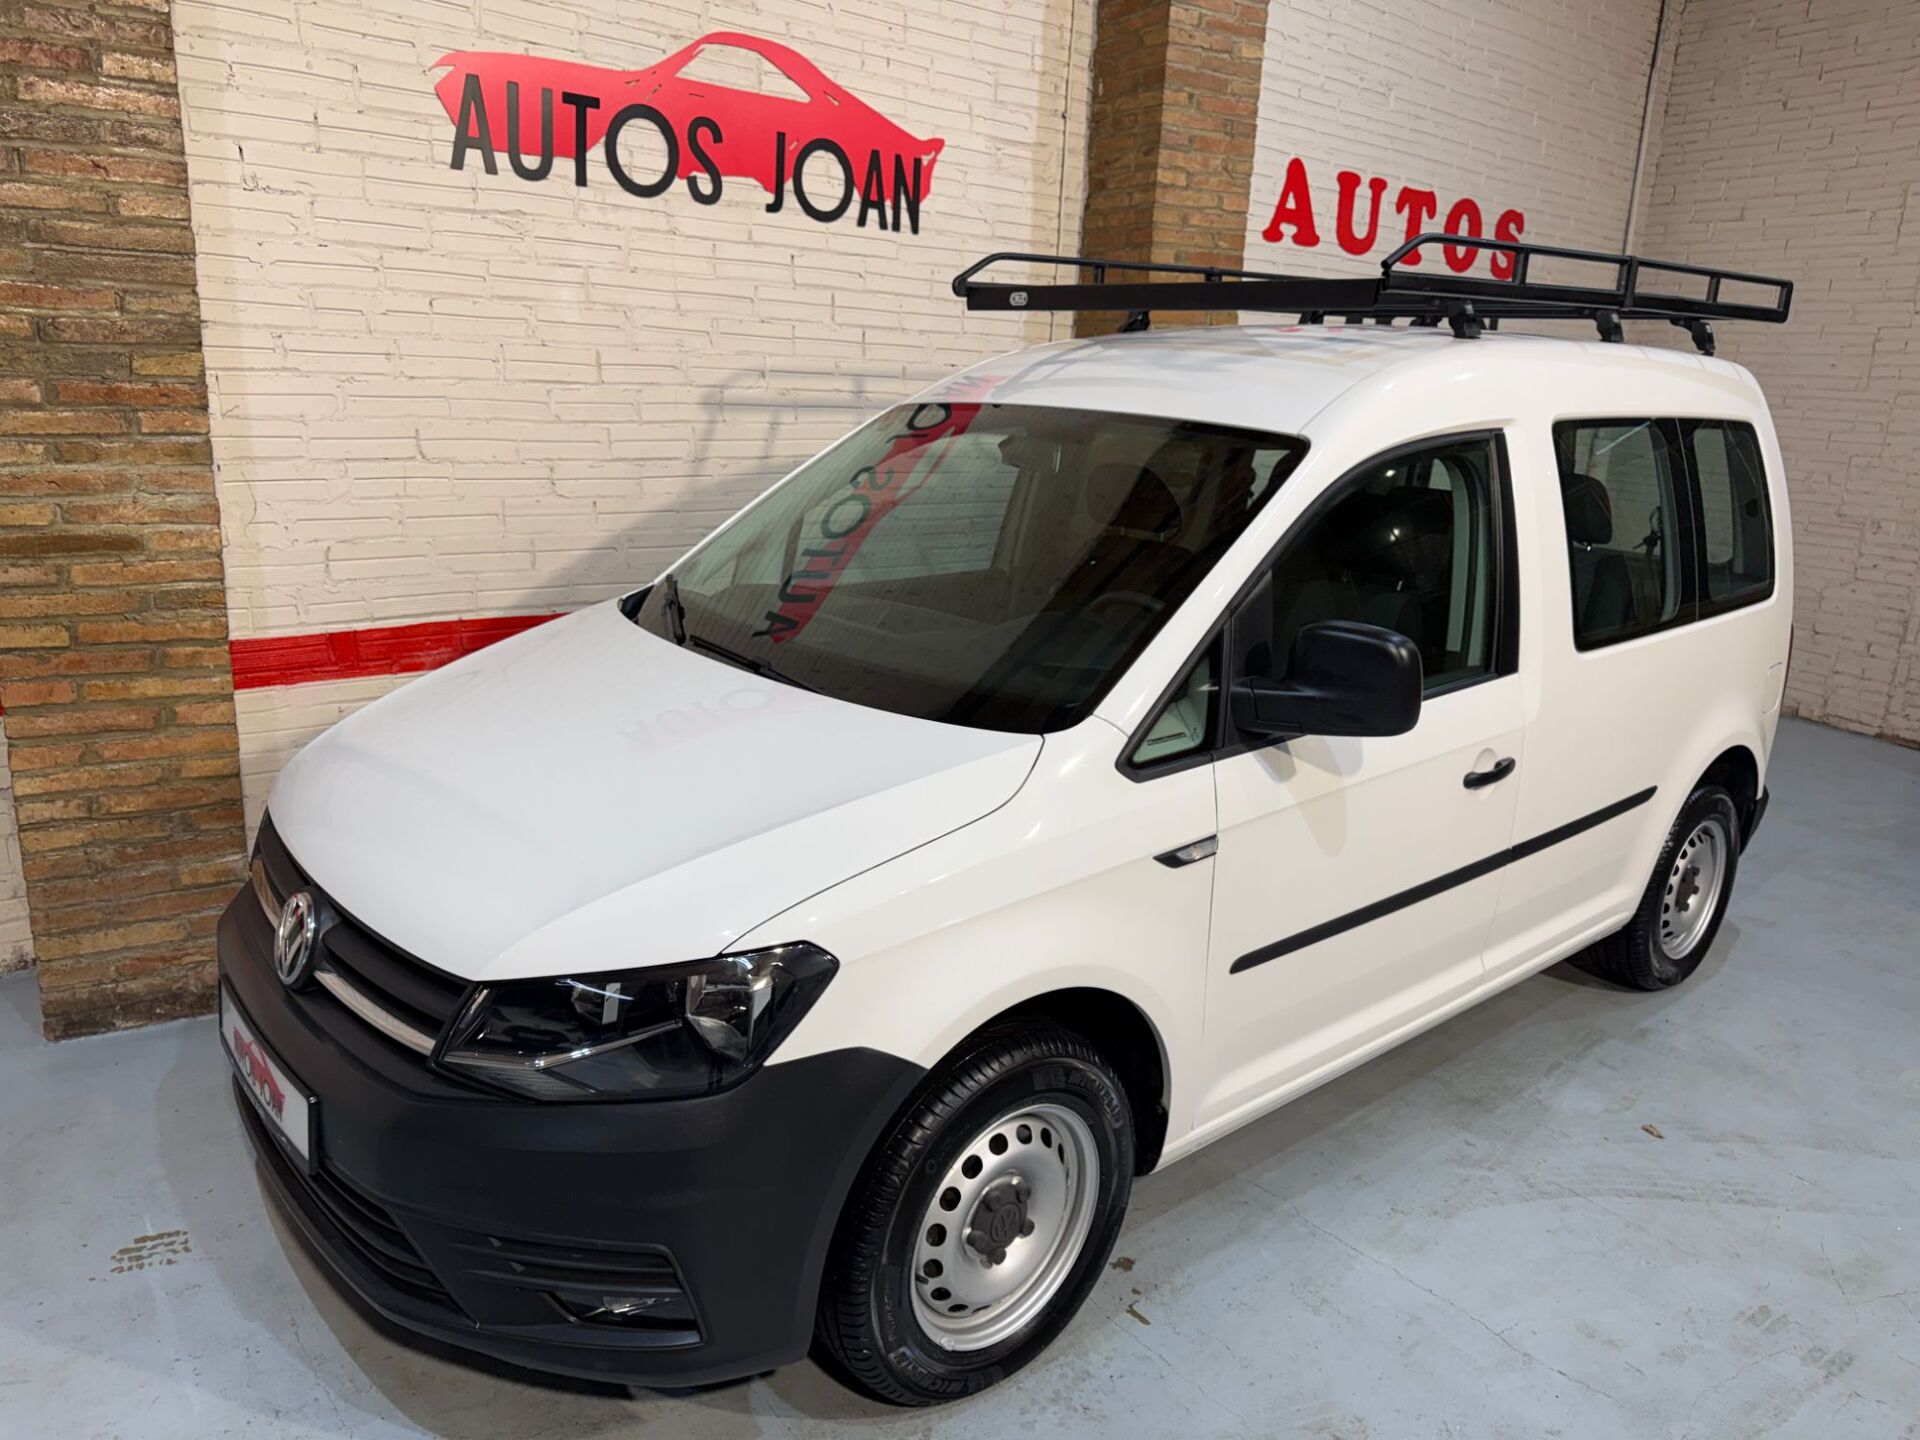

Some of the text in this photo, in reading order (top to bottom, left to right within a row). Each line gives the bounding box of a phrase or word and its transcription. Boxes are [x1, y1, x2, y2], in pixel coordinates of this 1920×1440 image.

[450, 73, 921, 234] AUTOS JOAN
[1262, 157, 1525, 281] AUTOS
